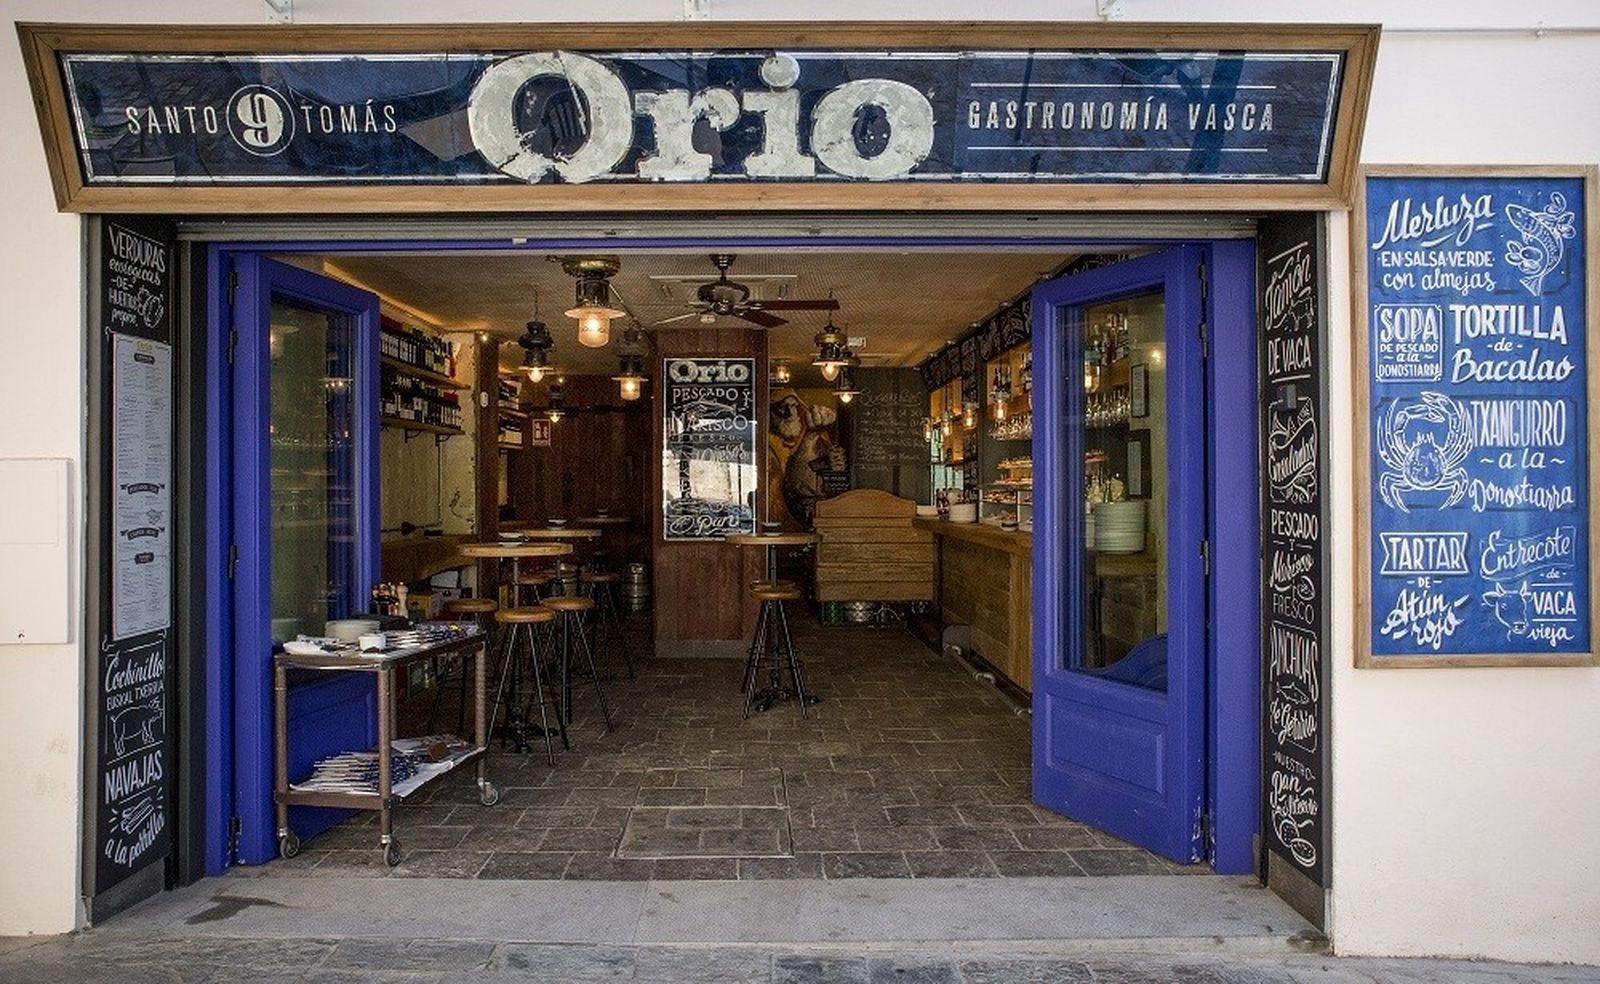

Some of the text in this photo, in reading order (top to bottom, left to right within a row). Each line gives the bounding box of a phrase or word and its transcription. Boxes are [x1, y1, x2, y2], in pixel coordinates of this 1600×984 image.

[125, 93, 397, 148] SANTO 9 TOMÁS
[467, 50, 935, 185] Orio
[967, 97, 1275, 133] GASTRONOMÍA VASCA
[1371, 193, 1497, 250] Merluza
[108, 225, 166, 273] VERDURAS
[1381, 250, 1494, 268] EN SALSA VERDE
[1383, 268, 1497, 296] con almejas
[1379, 307, 1440, 343] SOPA
[1449, 304, 1568, 345] TORTILLA
[1268, 334, 1312, 376] DE VACA
[1380, 343, 1439, 353] DE PESCADO
[1396, 351, 1421, 363] a la
[1494, 336, 1514, 352] de
[669, 360, 750, 383] Orio
[1377, 364, 1442, 377] DONOSTIARRA
[1451, 348, 1576, 384] Bacalao
[672, 387, 739, 404] PESCADO
[1470, 399, 1567, 448] TXANGURRO
[1498, 448, 1546, 470] a la
[1468, 476, 1575, 513] Donostiarra
[1271, 508, 1318, 541] PESCADO
[1388, 537, 1462, 570] TARTAR
[1417, 577, 1431, 589] DE
[1272, 593, 1315, 625] FRESCO
[1380, 589, 1447, 635] Atún
[1532, 590, 1577, 616] VACA
[1526, 623, 1575, 648] vieja
[104, 749, 163, 805] NAVAJAS
[104, 838, 115, 859] a
